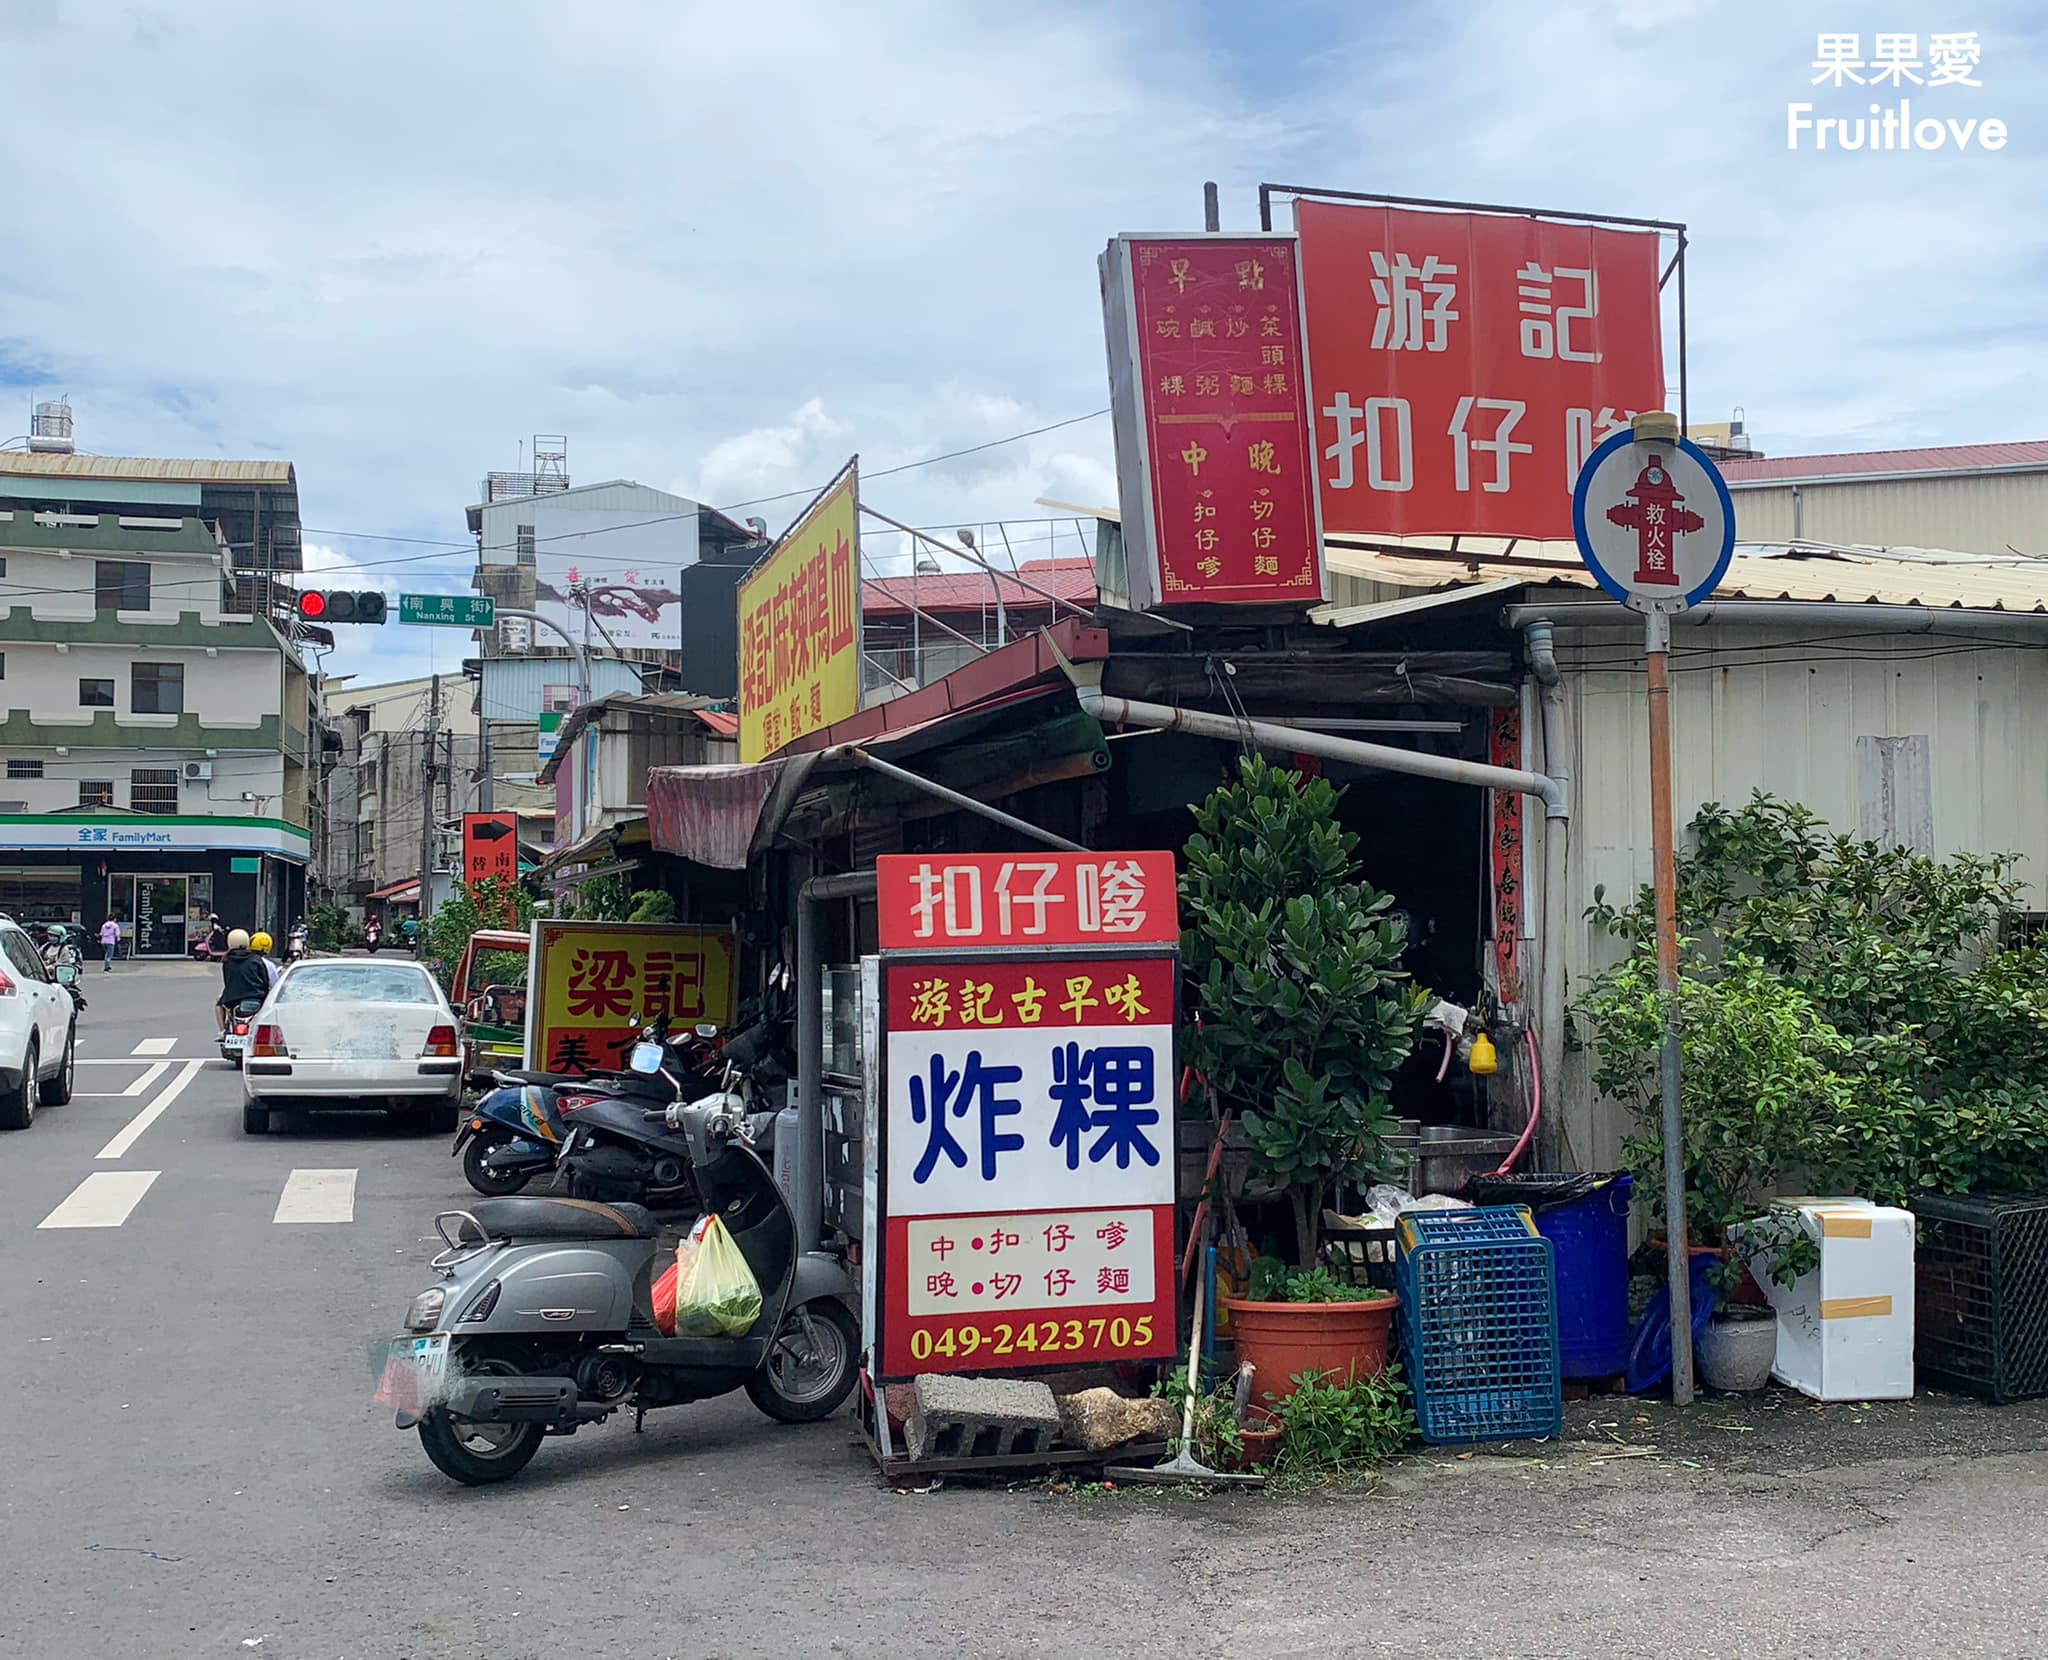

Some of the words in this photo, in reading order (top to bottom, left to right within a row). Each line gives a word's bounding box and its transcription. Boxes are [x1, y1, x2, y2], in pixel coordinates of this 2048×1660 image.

[1168, 258, 1265, 294] 早點
[1369, 251, 1603, 363] 游記
[1181, 440, 1207, 476] 中
[1248, 440, 1281, 475] 晚
[1250, 500, 1279, 576] 切仔麵
[1646, 503, 1666, 570] 救火栓
[410, 597, 485, 613] 南興街
[416, 611, 455, 622] Nanxing
[465, 614, 476, 622] St
[78, 828, 108, 842] 全家
[112, 831, 172, 845] FamilyMart
[138, 882, 154, 949] FamilyMart
[909, 860, 1148, 938] 扣仔嗲
[567, 948, 706, 1018] 梁記
[910, 973, 1150, 1027] 游記古早味
[908, 1041, 1160, 1185] 炸粿
[910, 1315, 1154, 1360] 049-2423705
